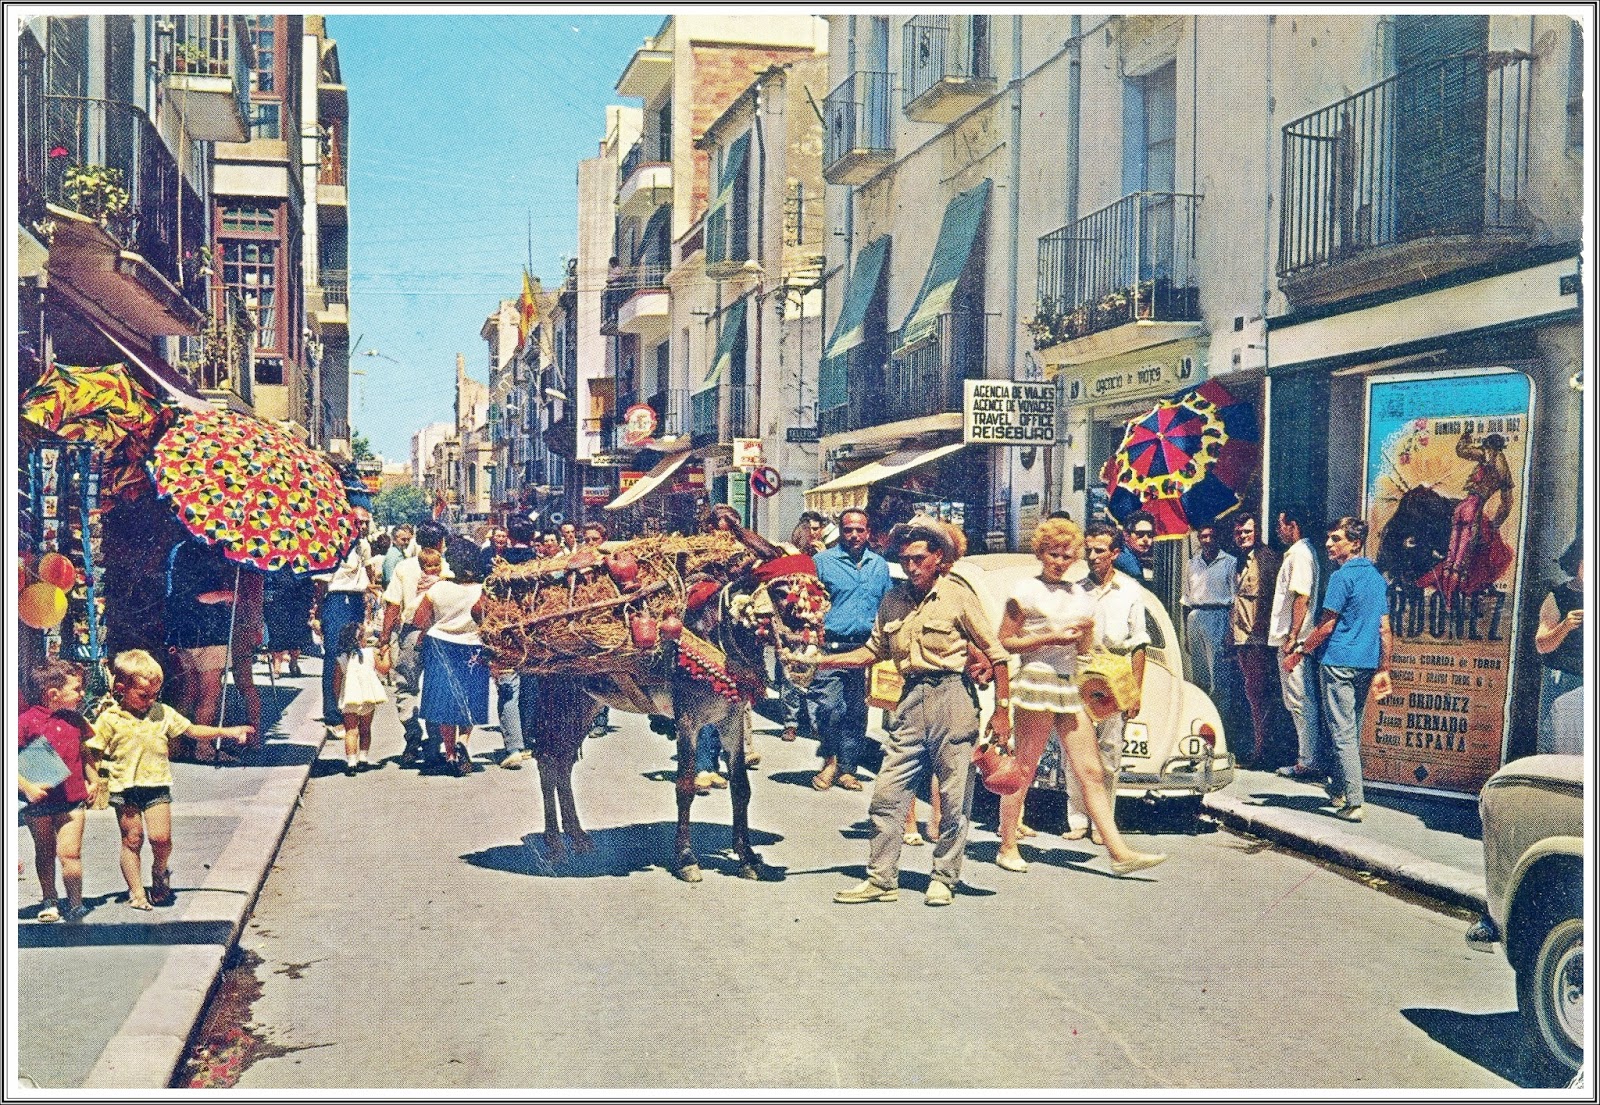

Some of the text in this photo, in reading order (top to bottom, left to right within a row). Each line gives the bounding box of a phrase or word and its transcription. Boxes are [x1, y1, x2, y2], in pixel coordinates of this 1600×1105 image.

[1137, 364, 1160, 385] viajes
[973, 385, 1055, 399] AGENCIA DE VIAJES
[973, 399, 1054, 412] AGENCE DE VOYAGES
[973, 412, 1054, 427] TRAVEL OFFICE
[1420, 654, 1455, 667] CORRIDA
[1473, 658, 1502, 670] TOROS
[1409, 692, 1470, 713] ORDOÑEZ
[1122, 740, 1149, 755] 228
[1189, 738, 1200, 755] D
[1405, 730, 1466, 753] ESPAÑA
